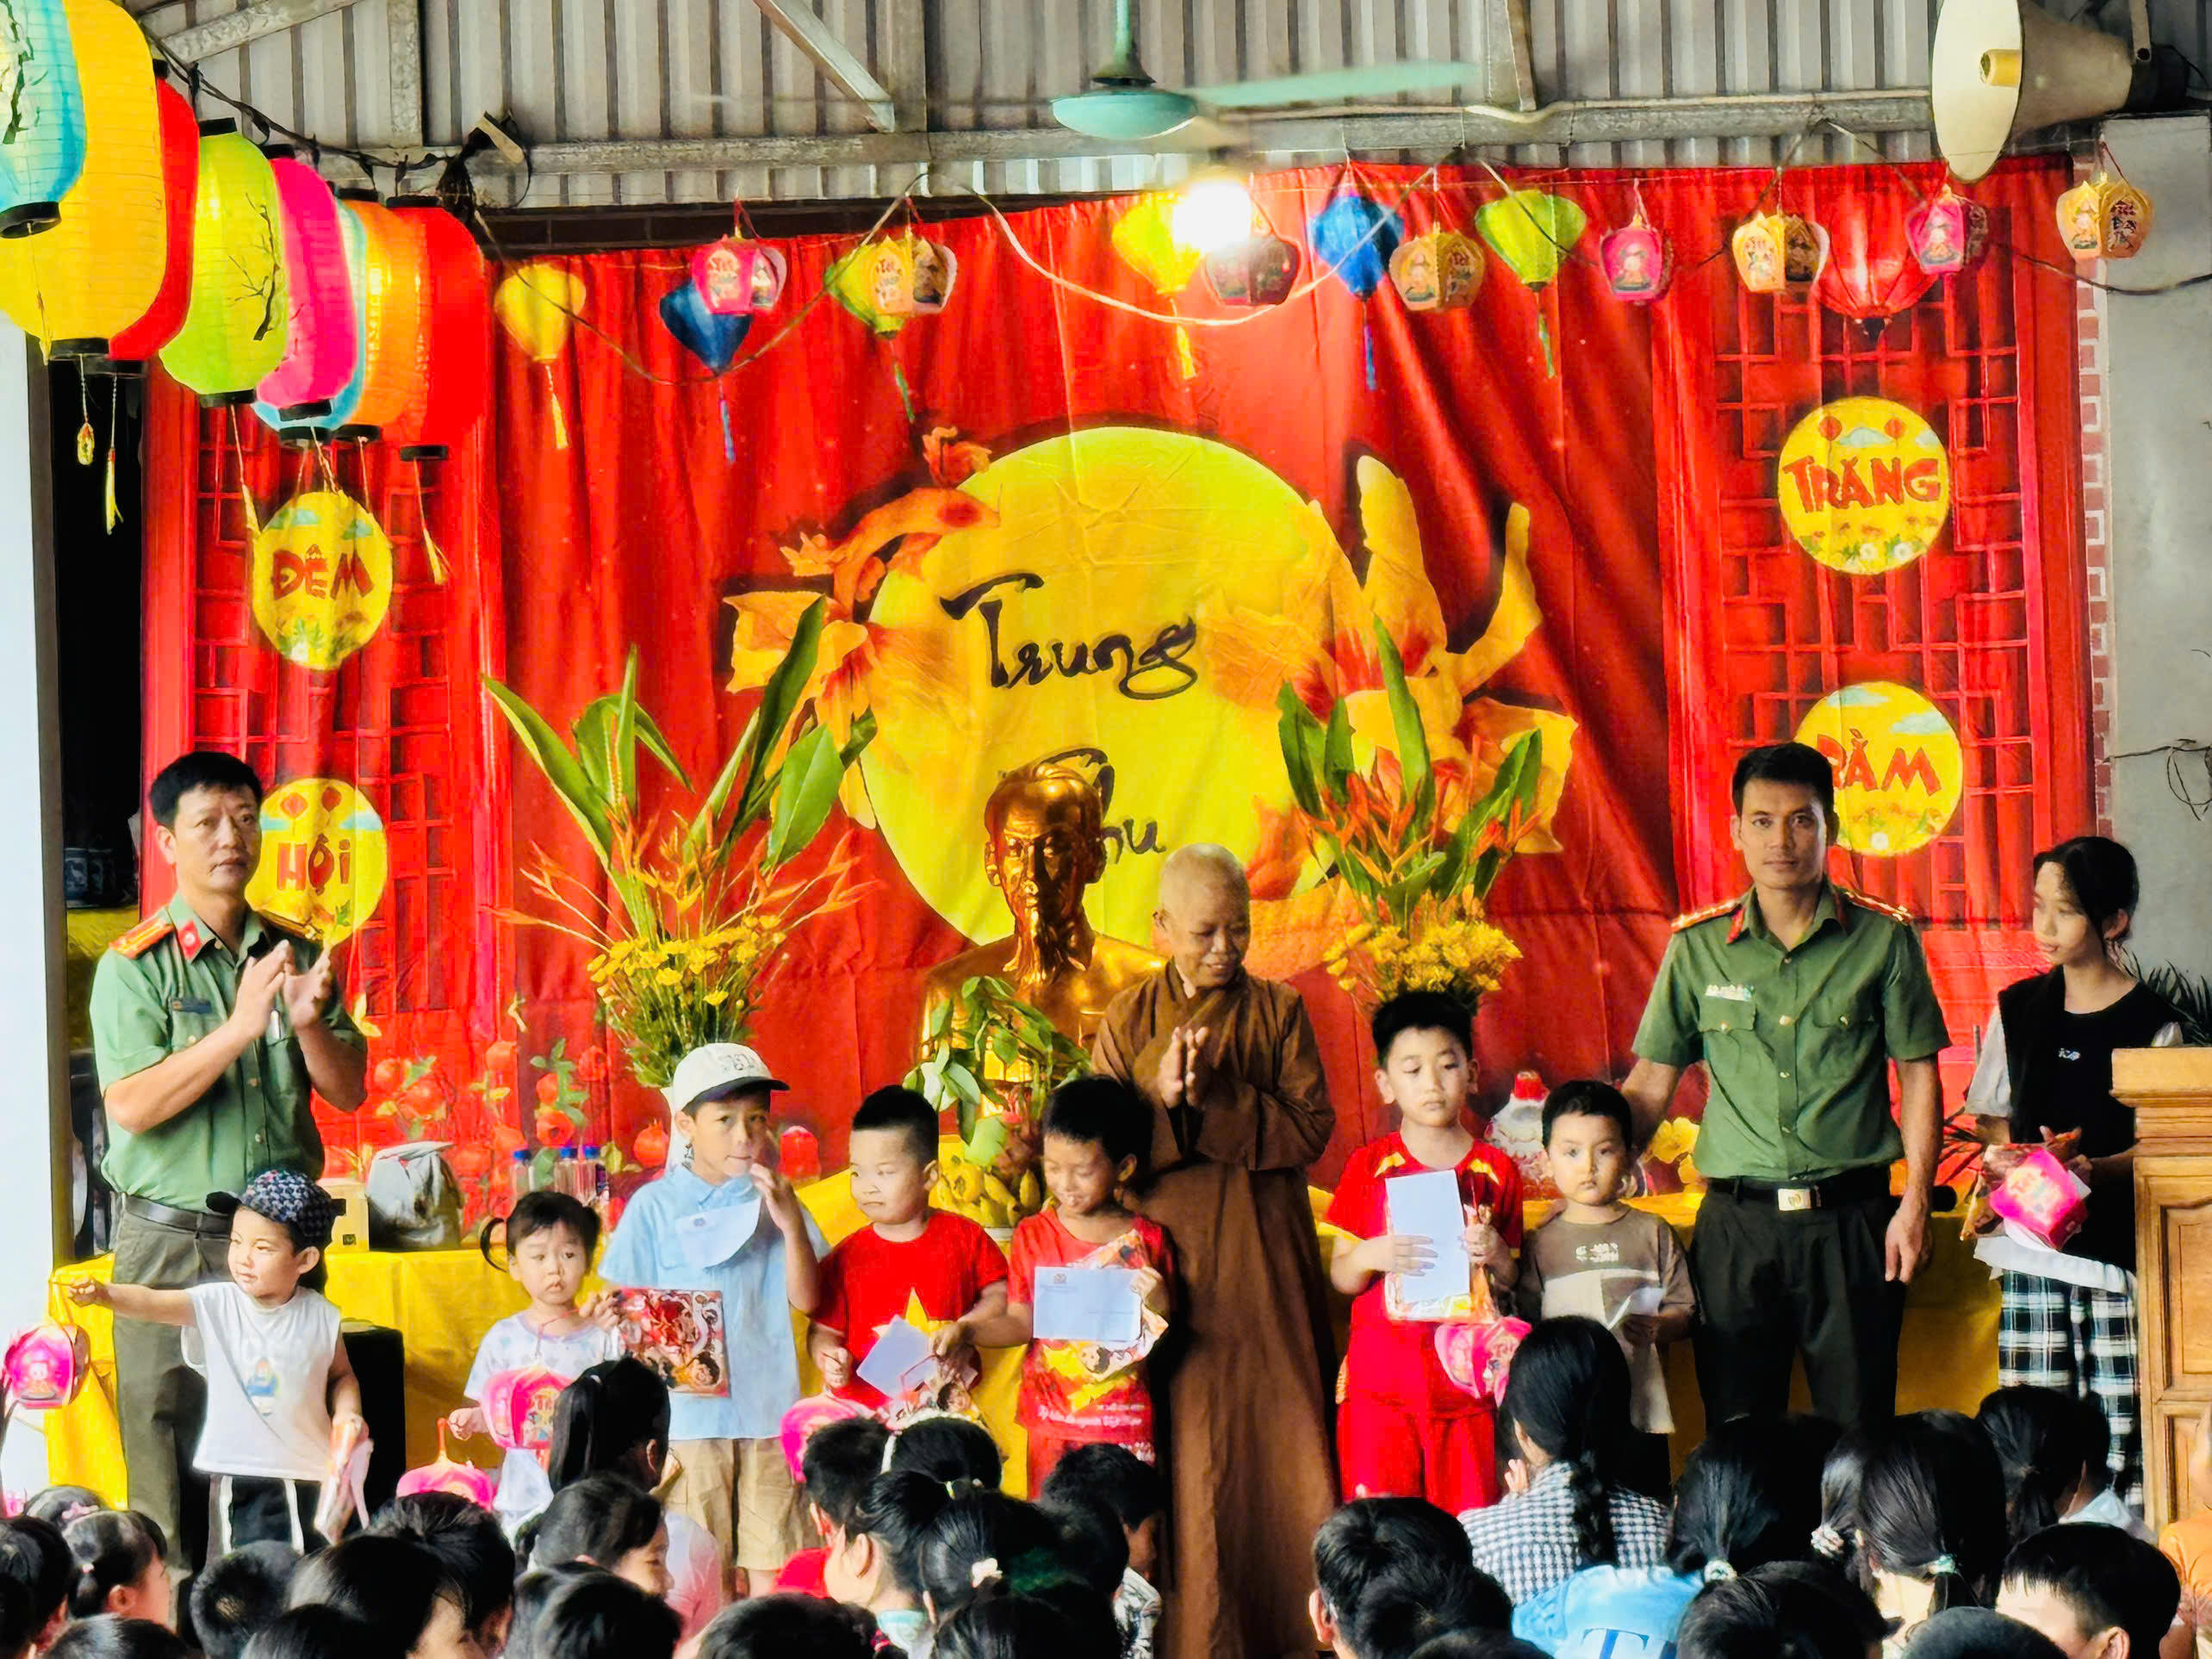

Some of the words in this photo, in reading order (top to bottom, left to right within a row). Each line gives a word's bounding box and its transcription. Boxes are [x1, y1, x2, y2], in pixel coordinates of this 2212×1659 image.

[1782, 455, 1942, 514] TRĂNG
[271, 544, 375, 601] ĐÊM
[939, 572, 1198, 701] Trung
